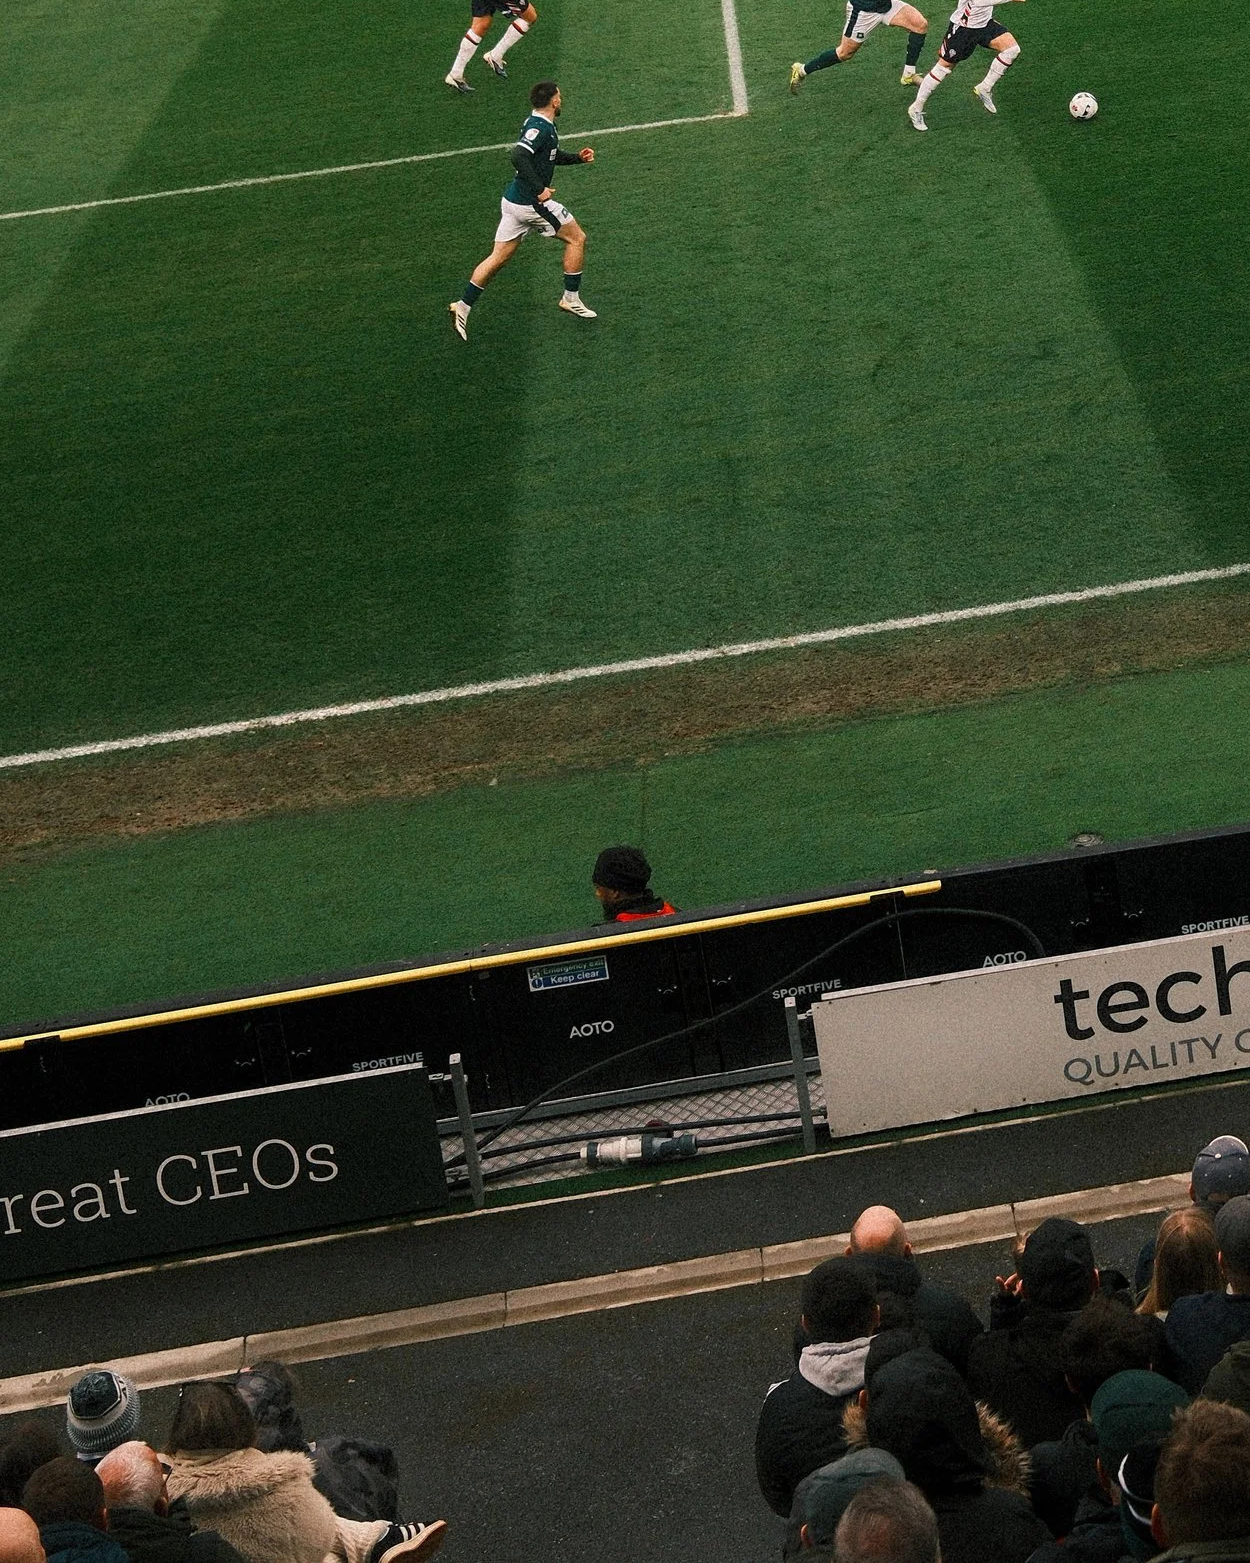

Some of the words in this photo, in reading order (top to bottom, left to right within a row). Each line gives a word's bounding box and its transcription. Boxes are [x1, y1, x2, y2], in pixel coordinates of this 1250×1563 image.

[1181, 915, 1249, 935] SPORTFIVE
[543, 962, 587, 975] Emergency
[589, 959, 604, 967] exit
[983, 950, 1027, 968] AOTO
[550, 974, 574, 984] Keep
[577, 970, 600, 979] clear
[772, 979, 841, 1000] SPORTFIVE
[569, 1020, 614, 1038] AOTO
[352, 1051, 424, 1072] SPORTFIVE
[1064, 1033, 1223, 1086] QUALITY
[156, 1138, 339, 1207] CEOs
